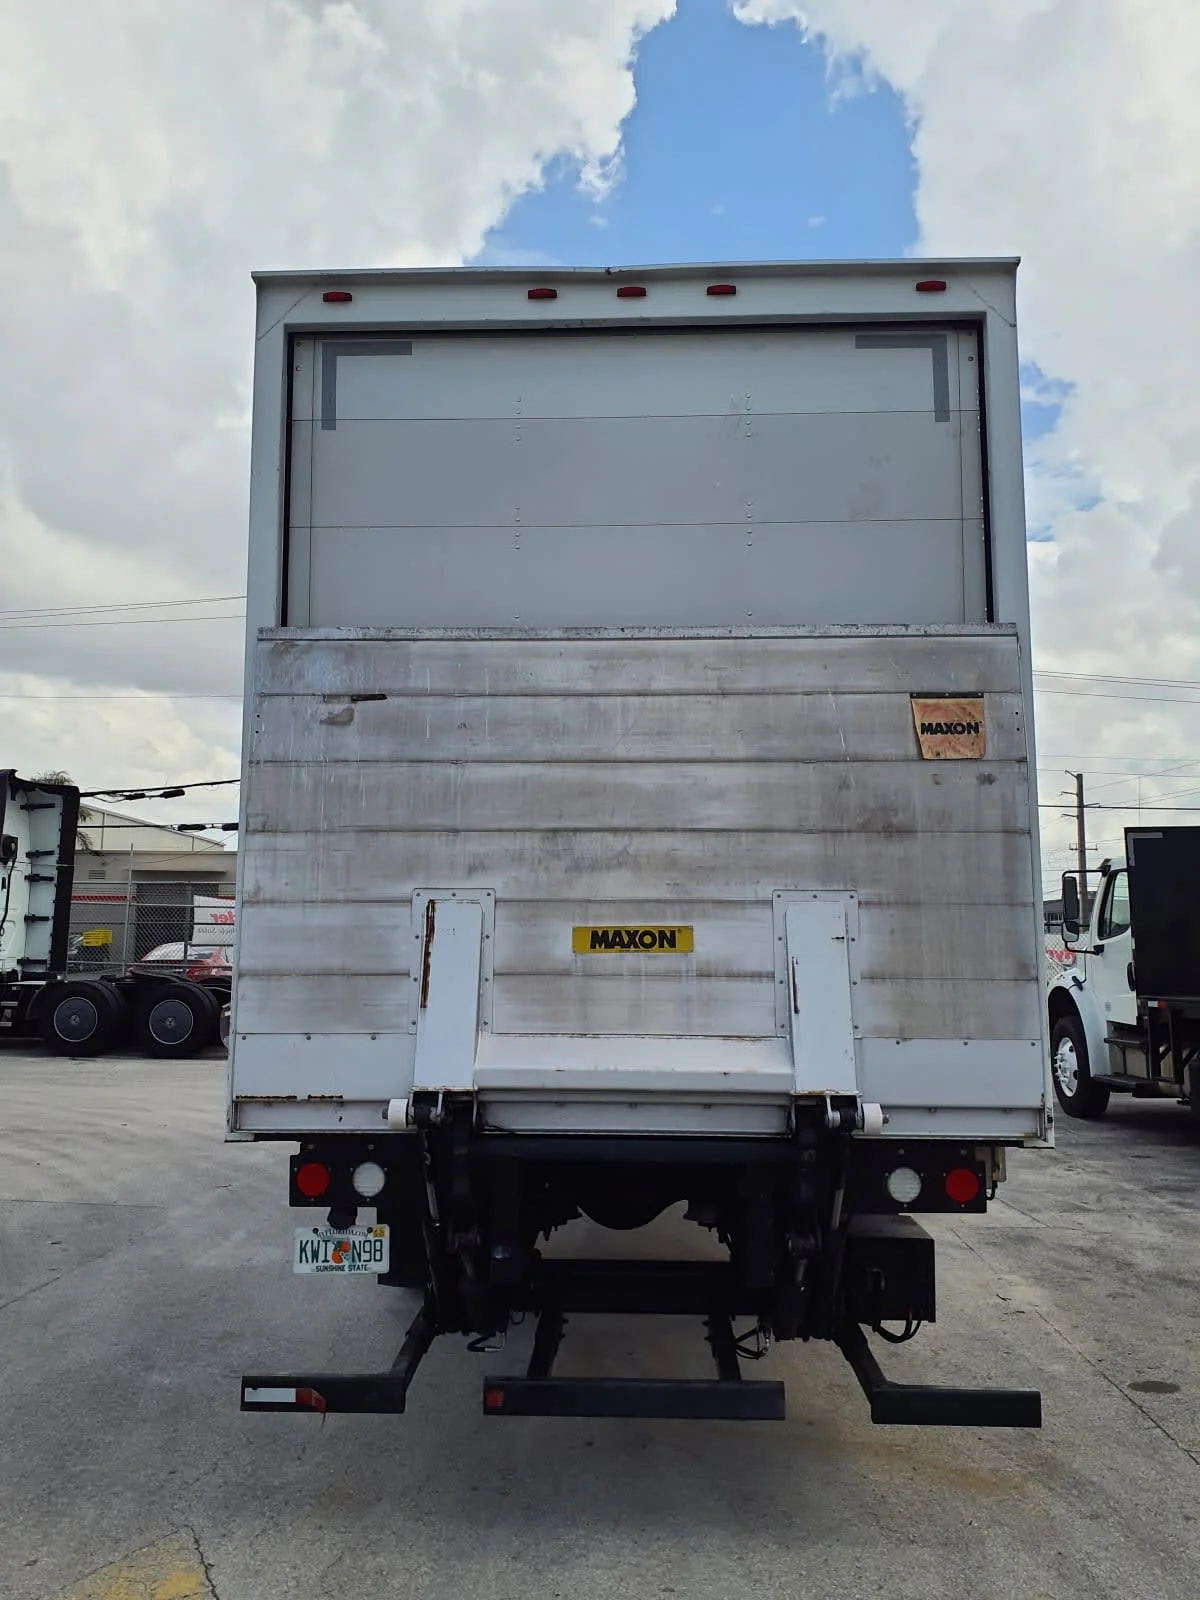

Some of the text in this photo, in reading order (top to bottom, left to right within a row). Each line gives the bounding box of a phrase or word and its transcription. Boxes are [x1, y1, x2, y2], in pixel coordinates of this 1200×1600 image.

[920, 722, 980, 735] MAXON
[590, 929, 677, 949] MAXON
[299, 1239, 384, 1264] KWI N98
[315, 1264, 369, 1273] SUNSHINE STATE
